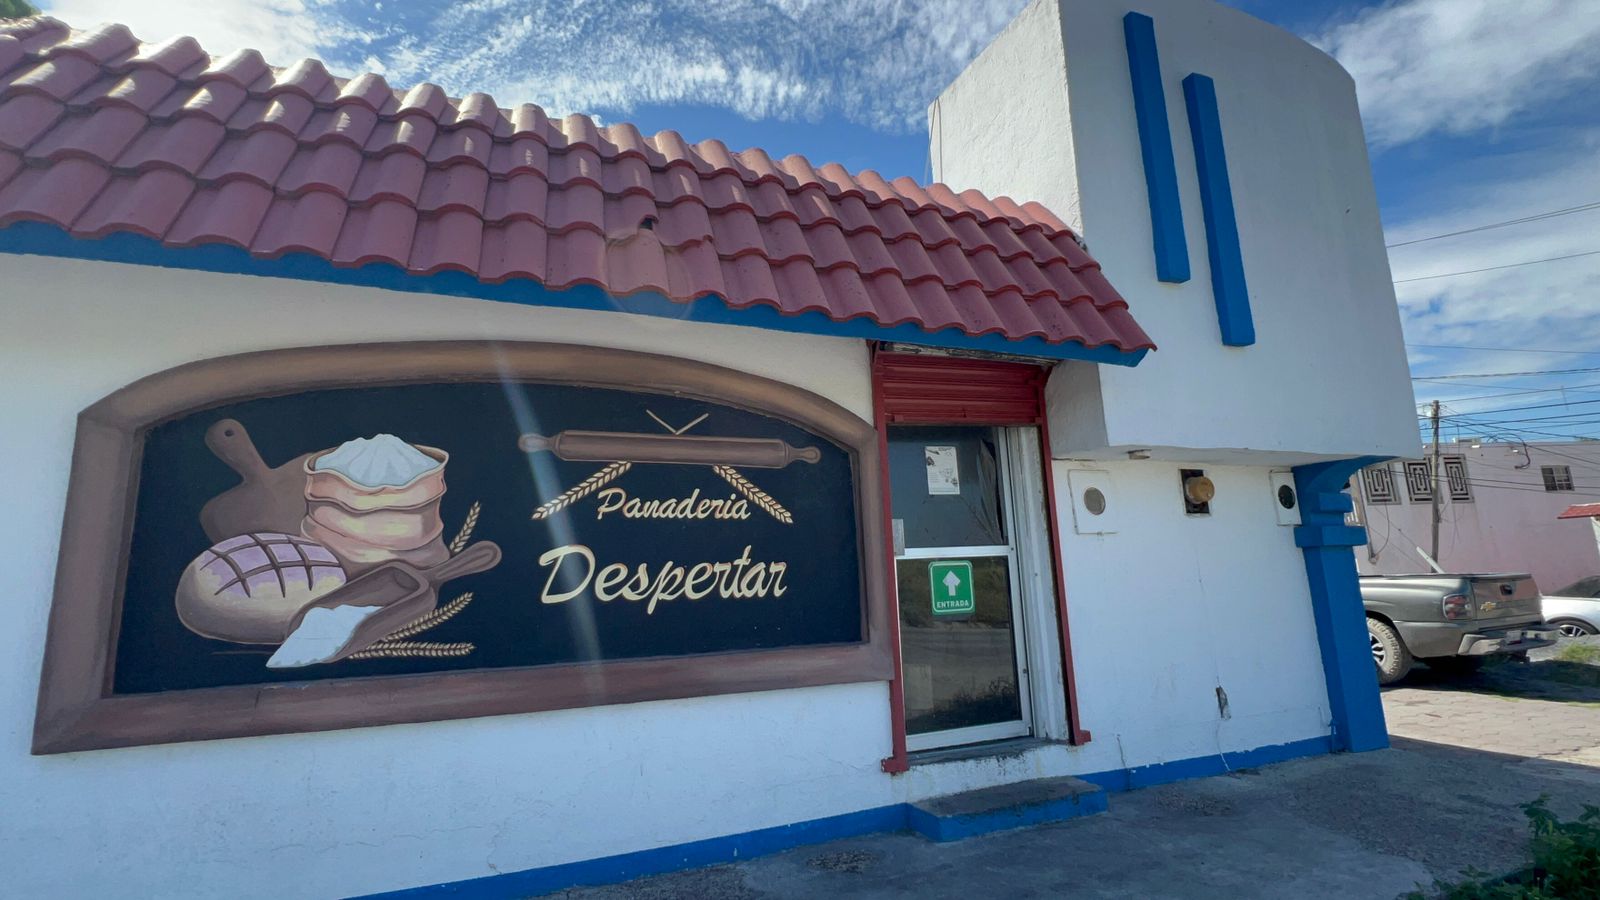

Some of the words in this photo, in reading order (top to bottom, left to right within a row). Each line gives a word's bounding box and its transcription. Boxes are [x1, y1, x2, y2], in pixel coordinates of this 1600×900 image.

[597, 487, 751, 520] Panaderia
[539, 544, 787, 614] Despertar
[936, 600, 969, 608] ENTRADA
